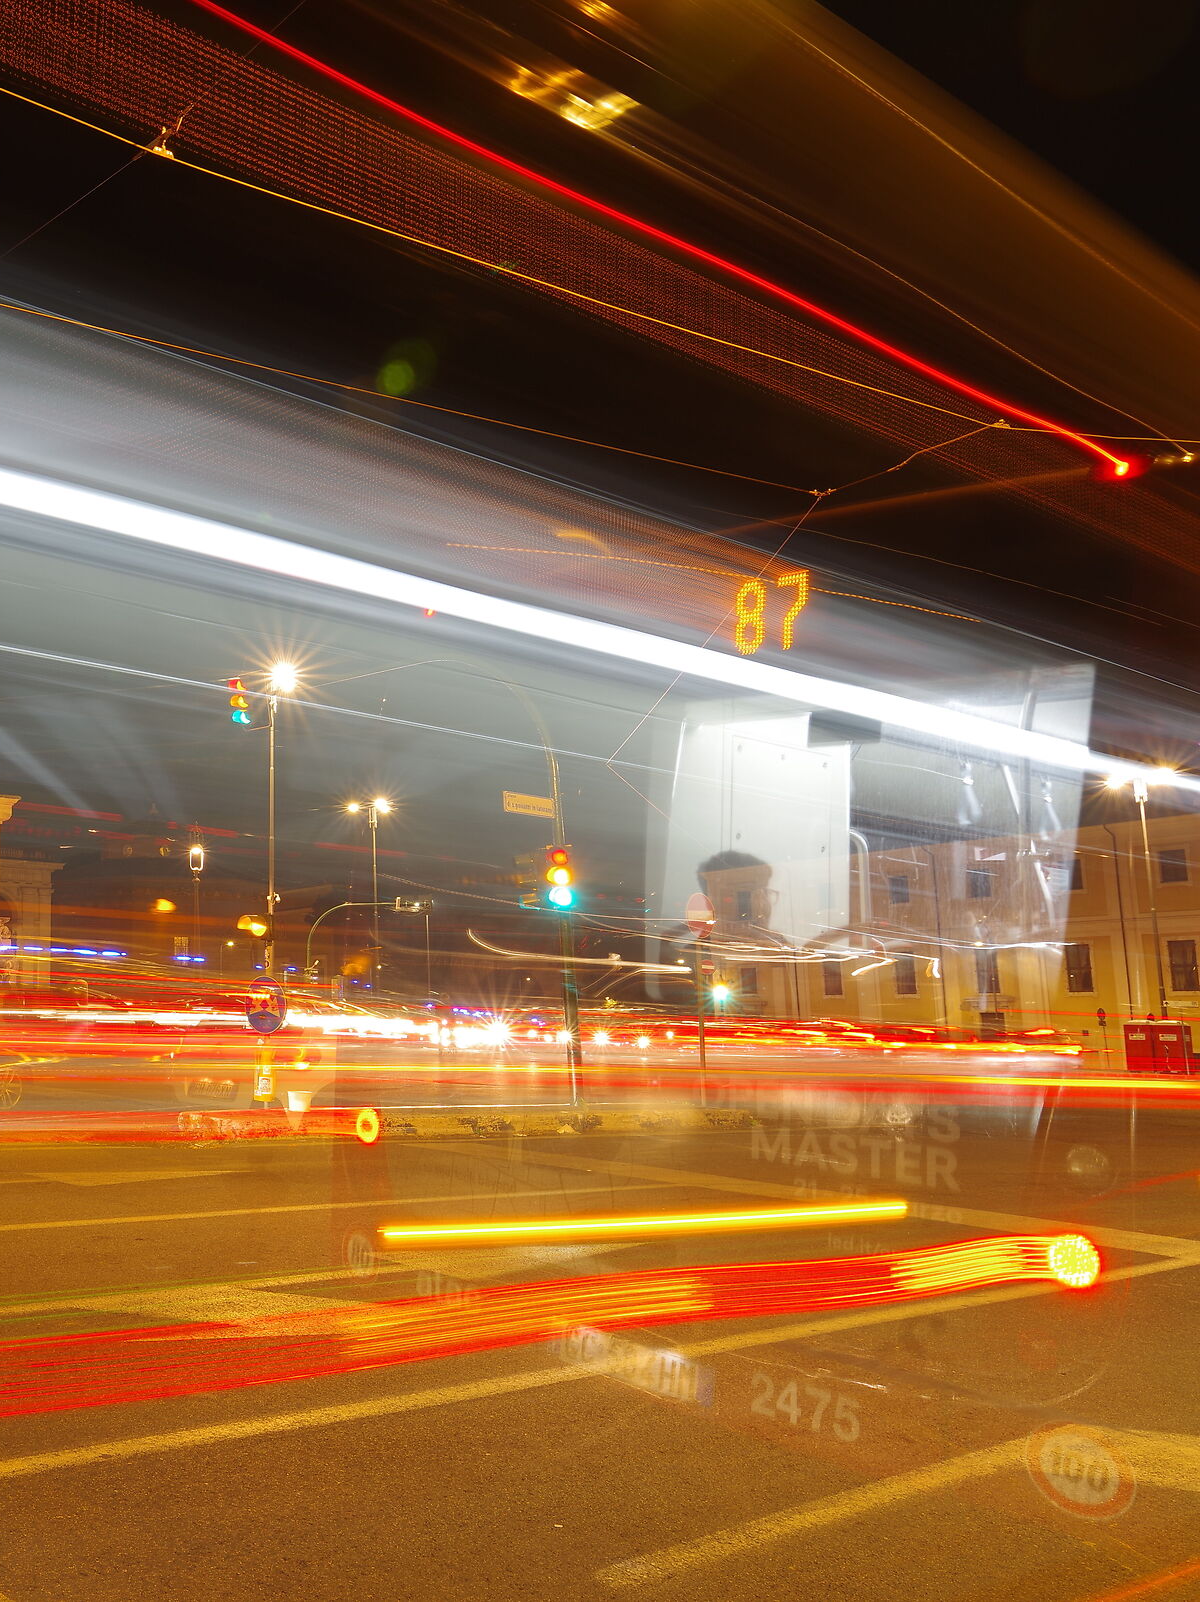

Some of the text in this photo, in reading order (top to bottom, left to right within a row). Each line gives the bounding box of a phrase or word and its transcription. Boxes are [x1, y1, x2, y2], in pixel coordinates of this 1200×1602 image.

[736, 569, 810, 655] 87
[750, 1126, 961, 1192] MASTER
[750, 1371, 860, 1442] 2475
[1050, 1444, 1109, 1493] 100
